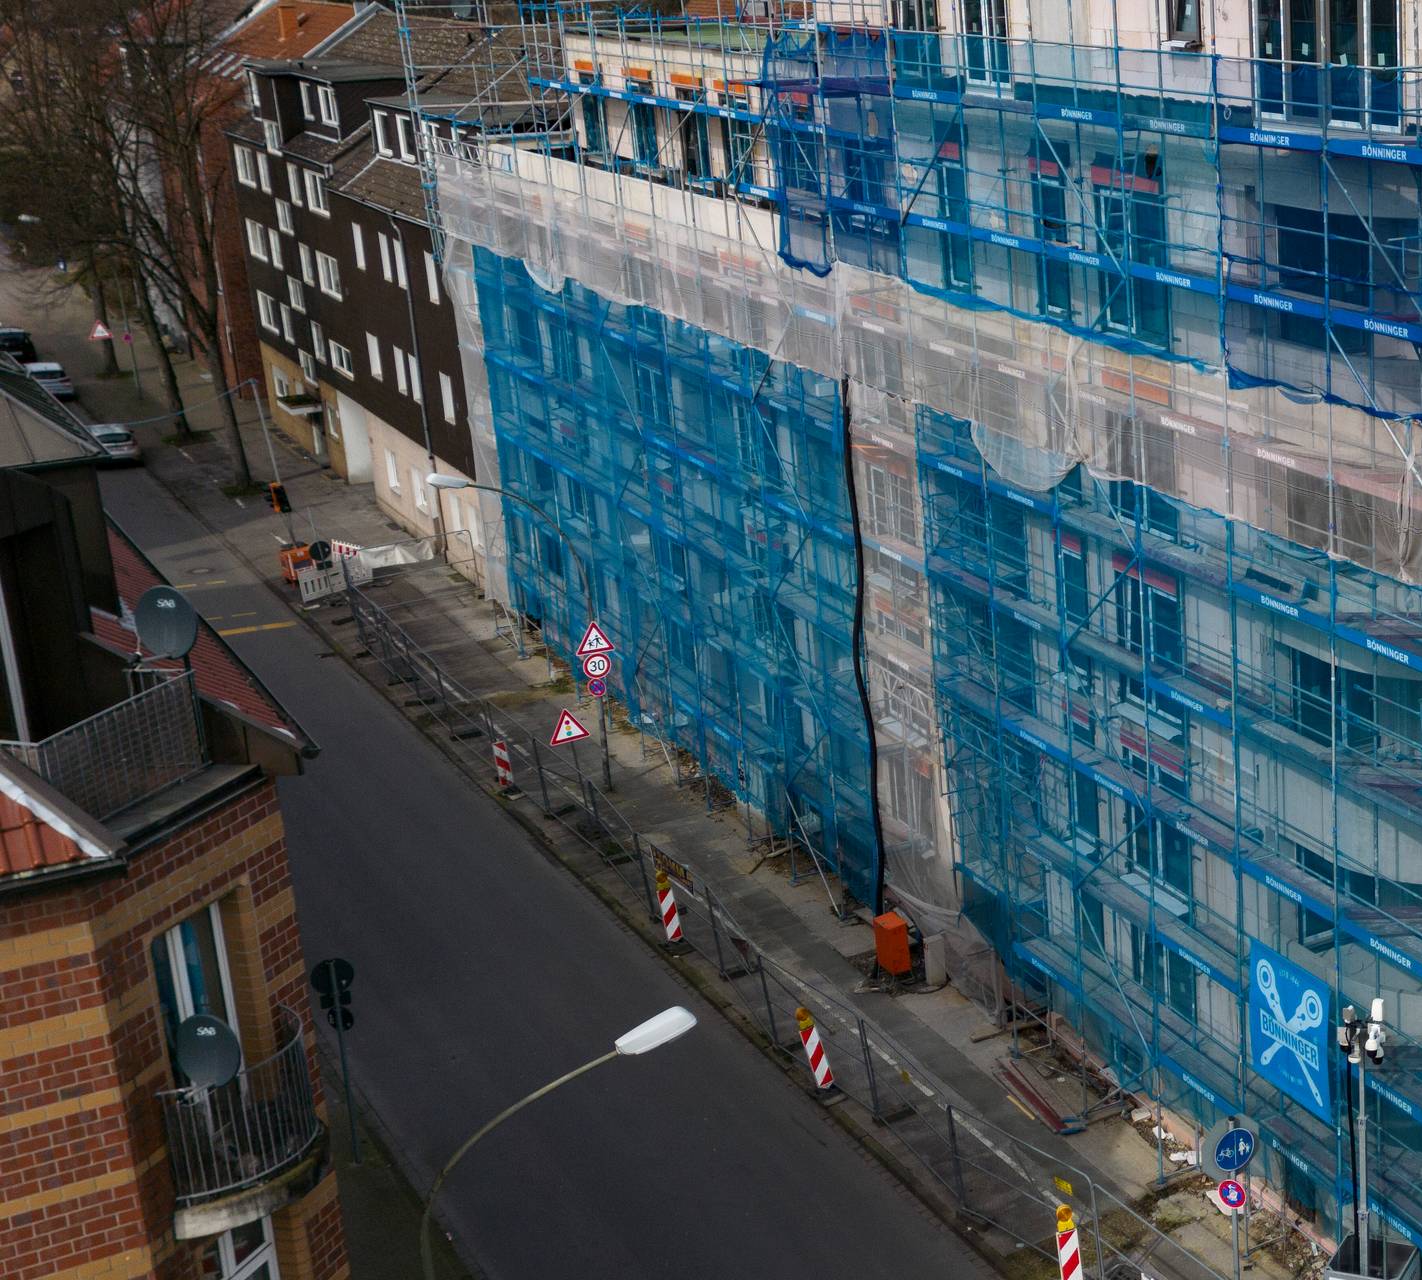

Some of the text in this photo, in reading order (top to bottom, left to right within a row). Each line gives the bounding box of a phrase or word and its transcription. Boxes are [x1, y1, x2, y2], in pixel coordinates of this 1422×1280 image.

[1061, 108, 1092, 121] BÖNNINGER
[1150, 119, 1185, 133] BÖNNINGER
[1250, 132, 1290, 146] BÖNNINGER
[1362, 145, 1407, 161] BÖNNINGER
[1069, 252, 1100, 266] BÖNNINGER
[1156, 272, 1191, 288] BÖNNINGER
[1254, 294, 1293, 312] BÖNNINGER
[1364, 320, 1409, 339] BÖNNINGER
[1257, 448, 1296, 467] BÖNNINGER
[1260, 595, 1299, 617] BÖNNINGER
[1366, 639, 1409, 664] BÖNNINGER
[590, 660, 605, 672] 30
[1265, 875, 1302, 902] BÖNNINGER
[1370, 937, 1412, 969] BÖNNINGER
[1262, 1014, 1318, 1066] BÖNNINGER
